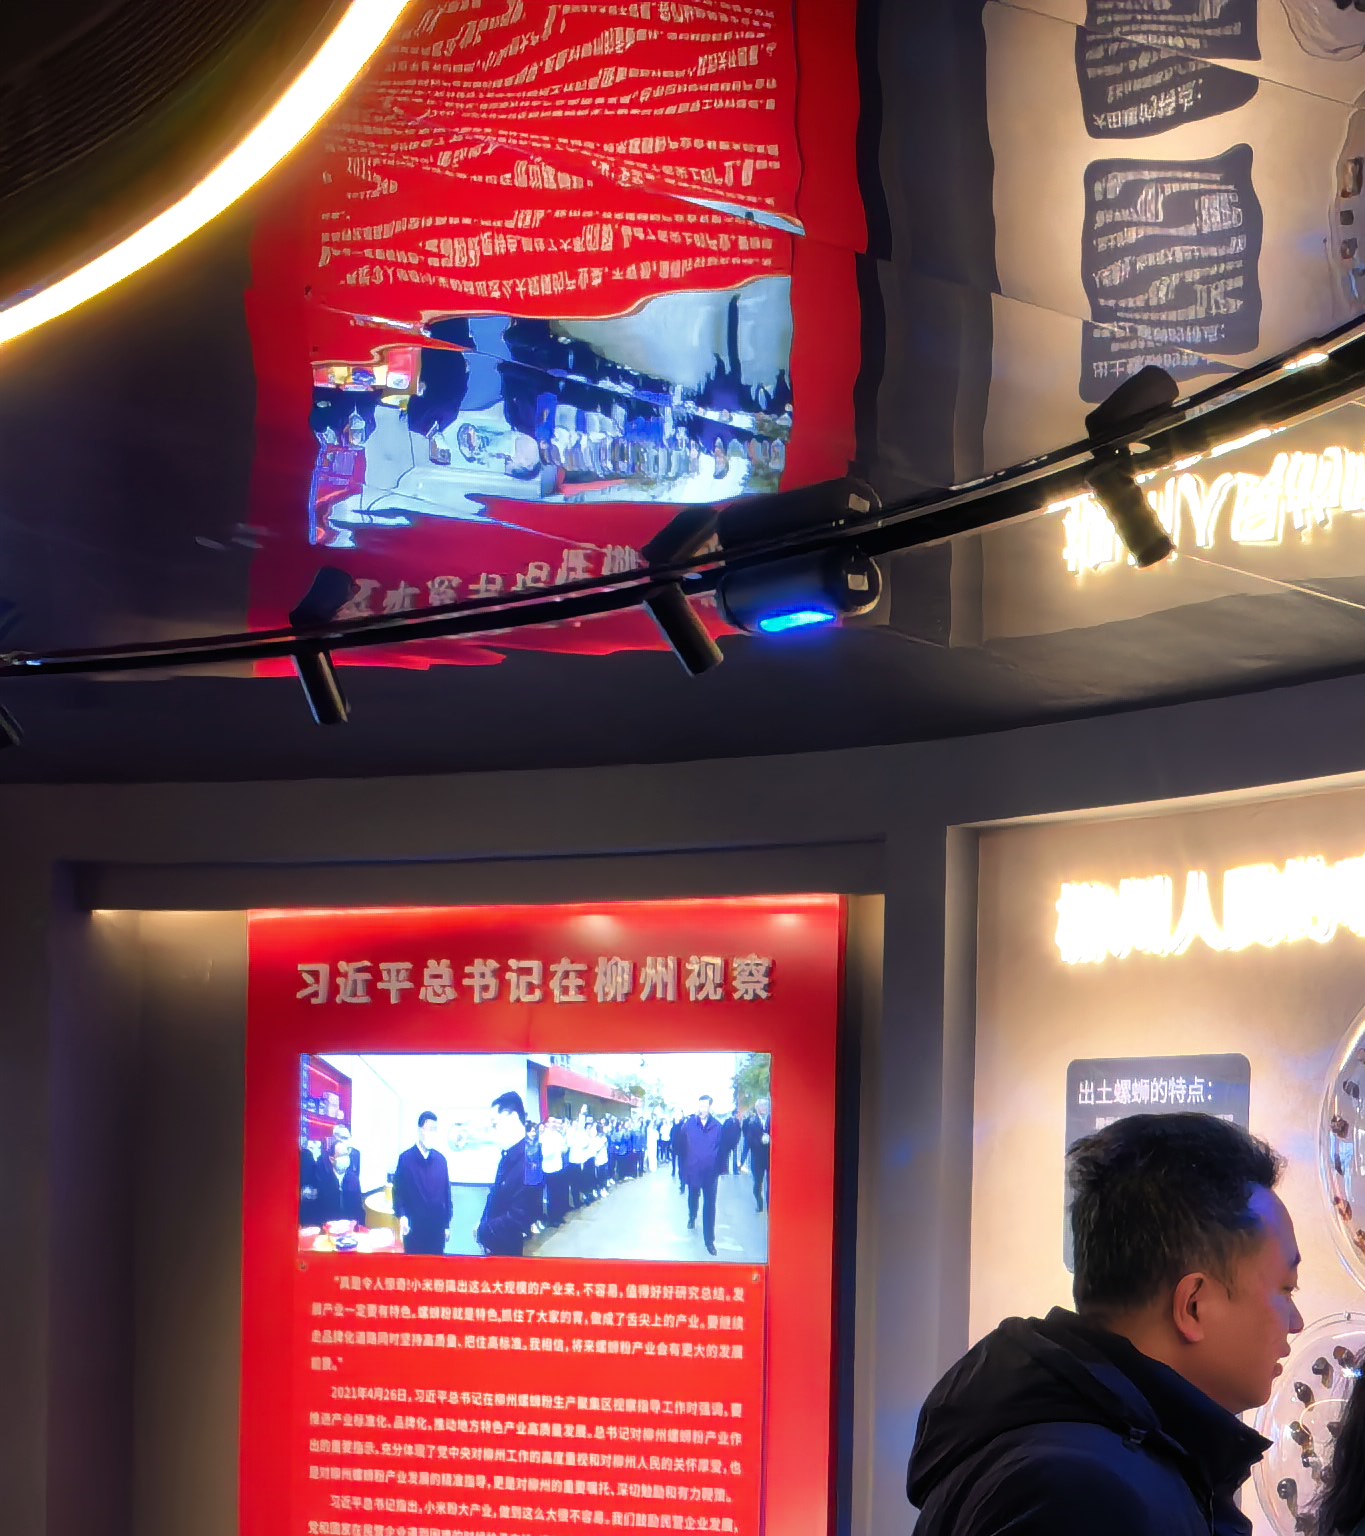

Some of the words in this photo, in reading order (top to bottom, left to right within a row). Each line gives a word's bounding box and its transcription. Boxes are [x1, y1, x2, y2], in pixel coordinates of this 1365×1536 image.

[296, 955, 775, 1006] 习近平总书记在柳州视察
